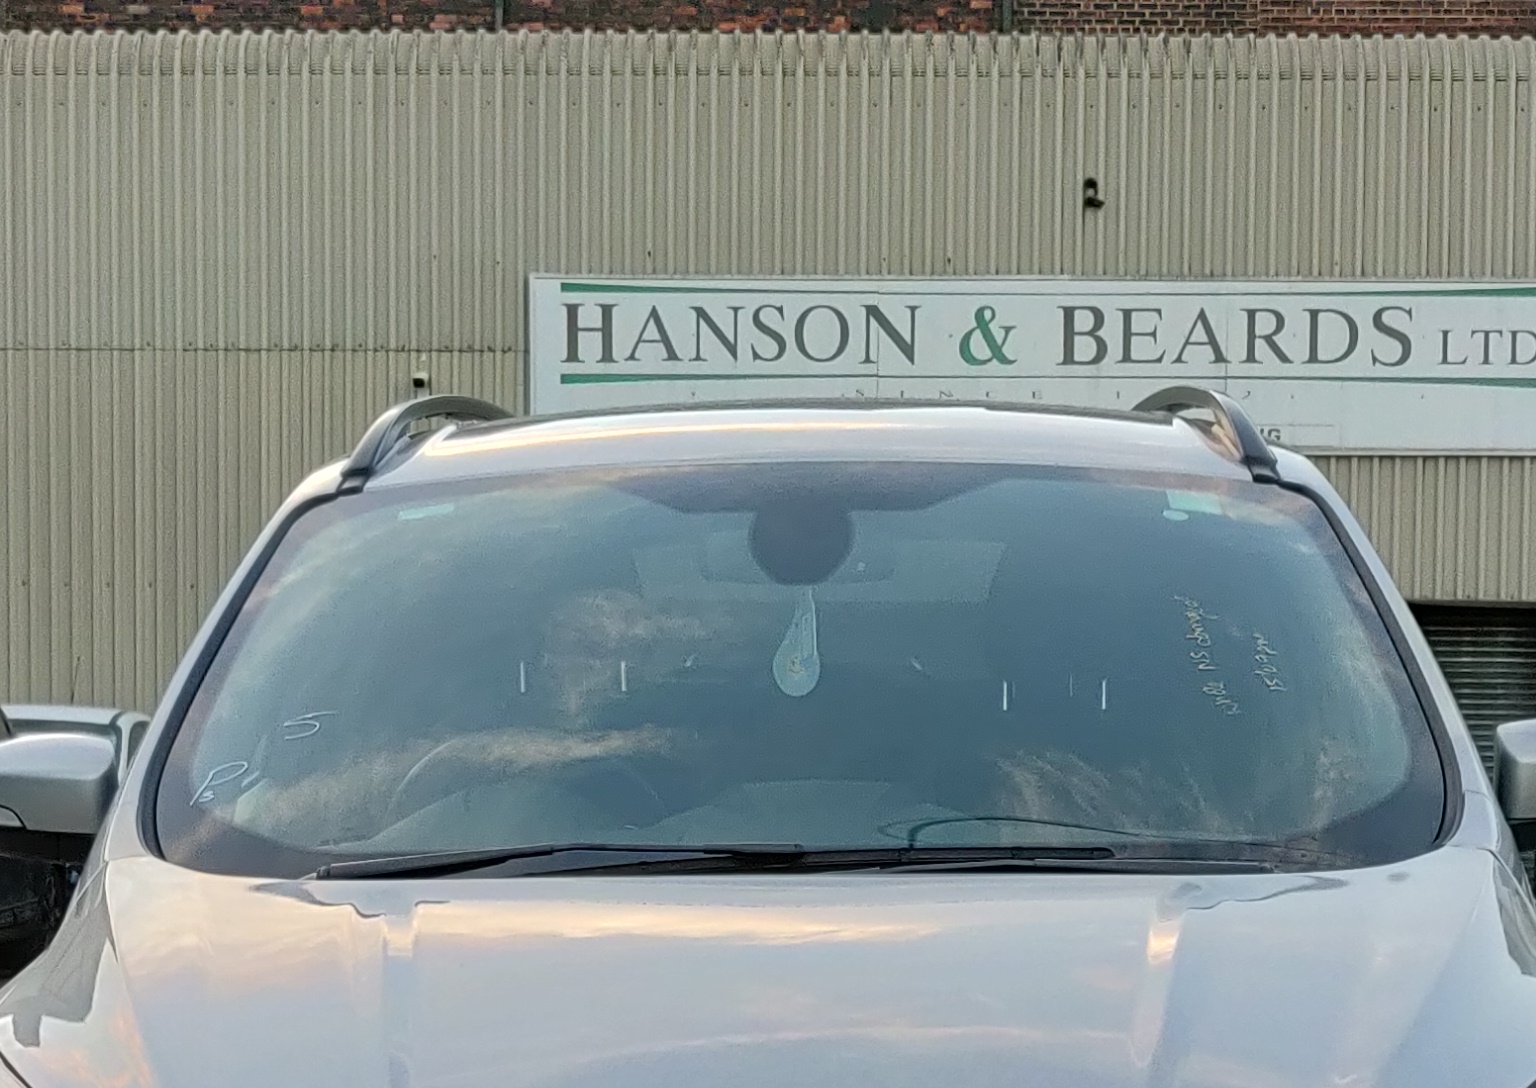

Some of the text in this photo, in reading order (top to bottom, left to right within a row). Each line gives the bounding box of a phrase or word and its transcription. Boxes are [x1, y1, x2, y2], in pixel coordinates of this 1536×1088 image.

[560, 302, 923, 365] HANSON
[958, 304, 1018, 367] &
[1055, 304, 1414, 368] BEARDS
